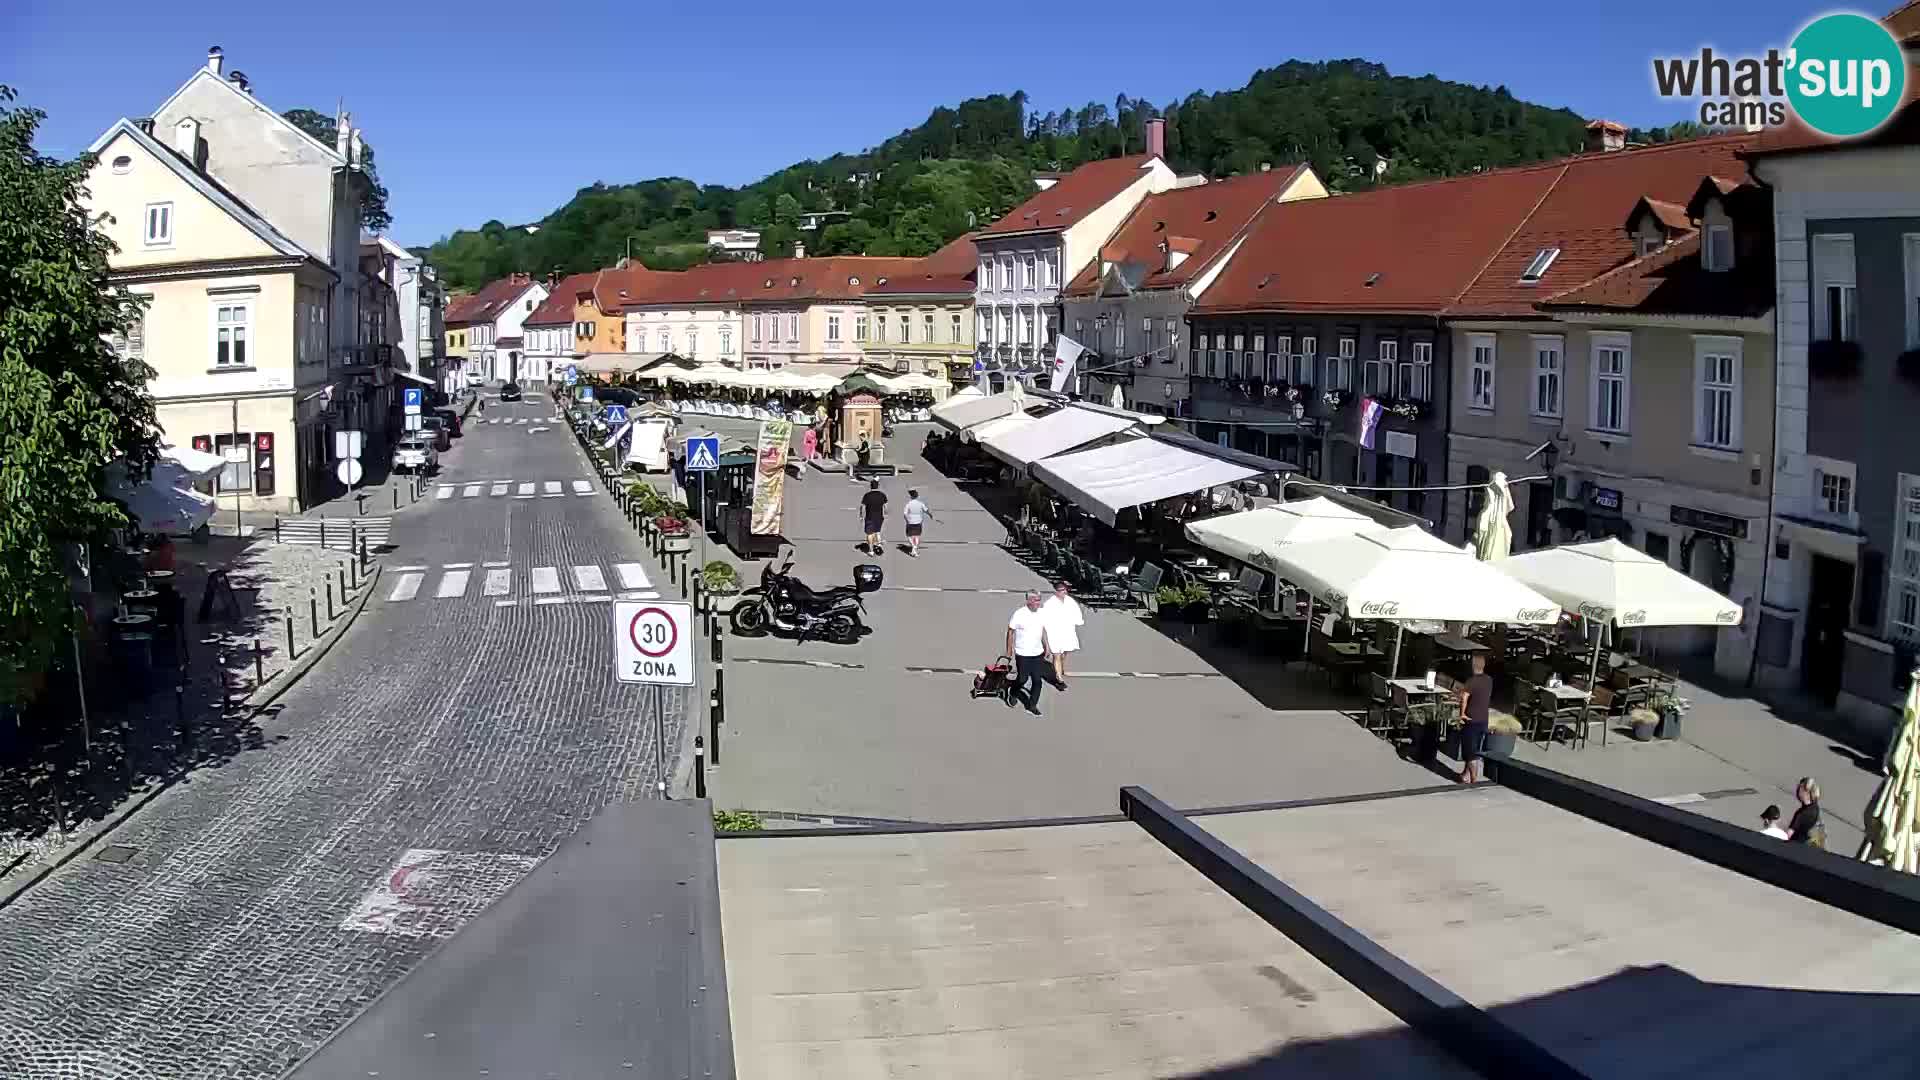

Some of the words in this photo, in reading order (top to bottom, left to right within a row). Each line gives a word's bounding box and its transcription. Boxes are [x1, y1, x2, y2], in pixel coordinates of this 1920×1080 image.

[408, 391, 417, 402] P
[642, 623, 666, 644] 30
[632, 660, 677, 677] ZONA
